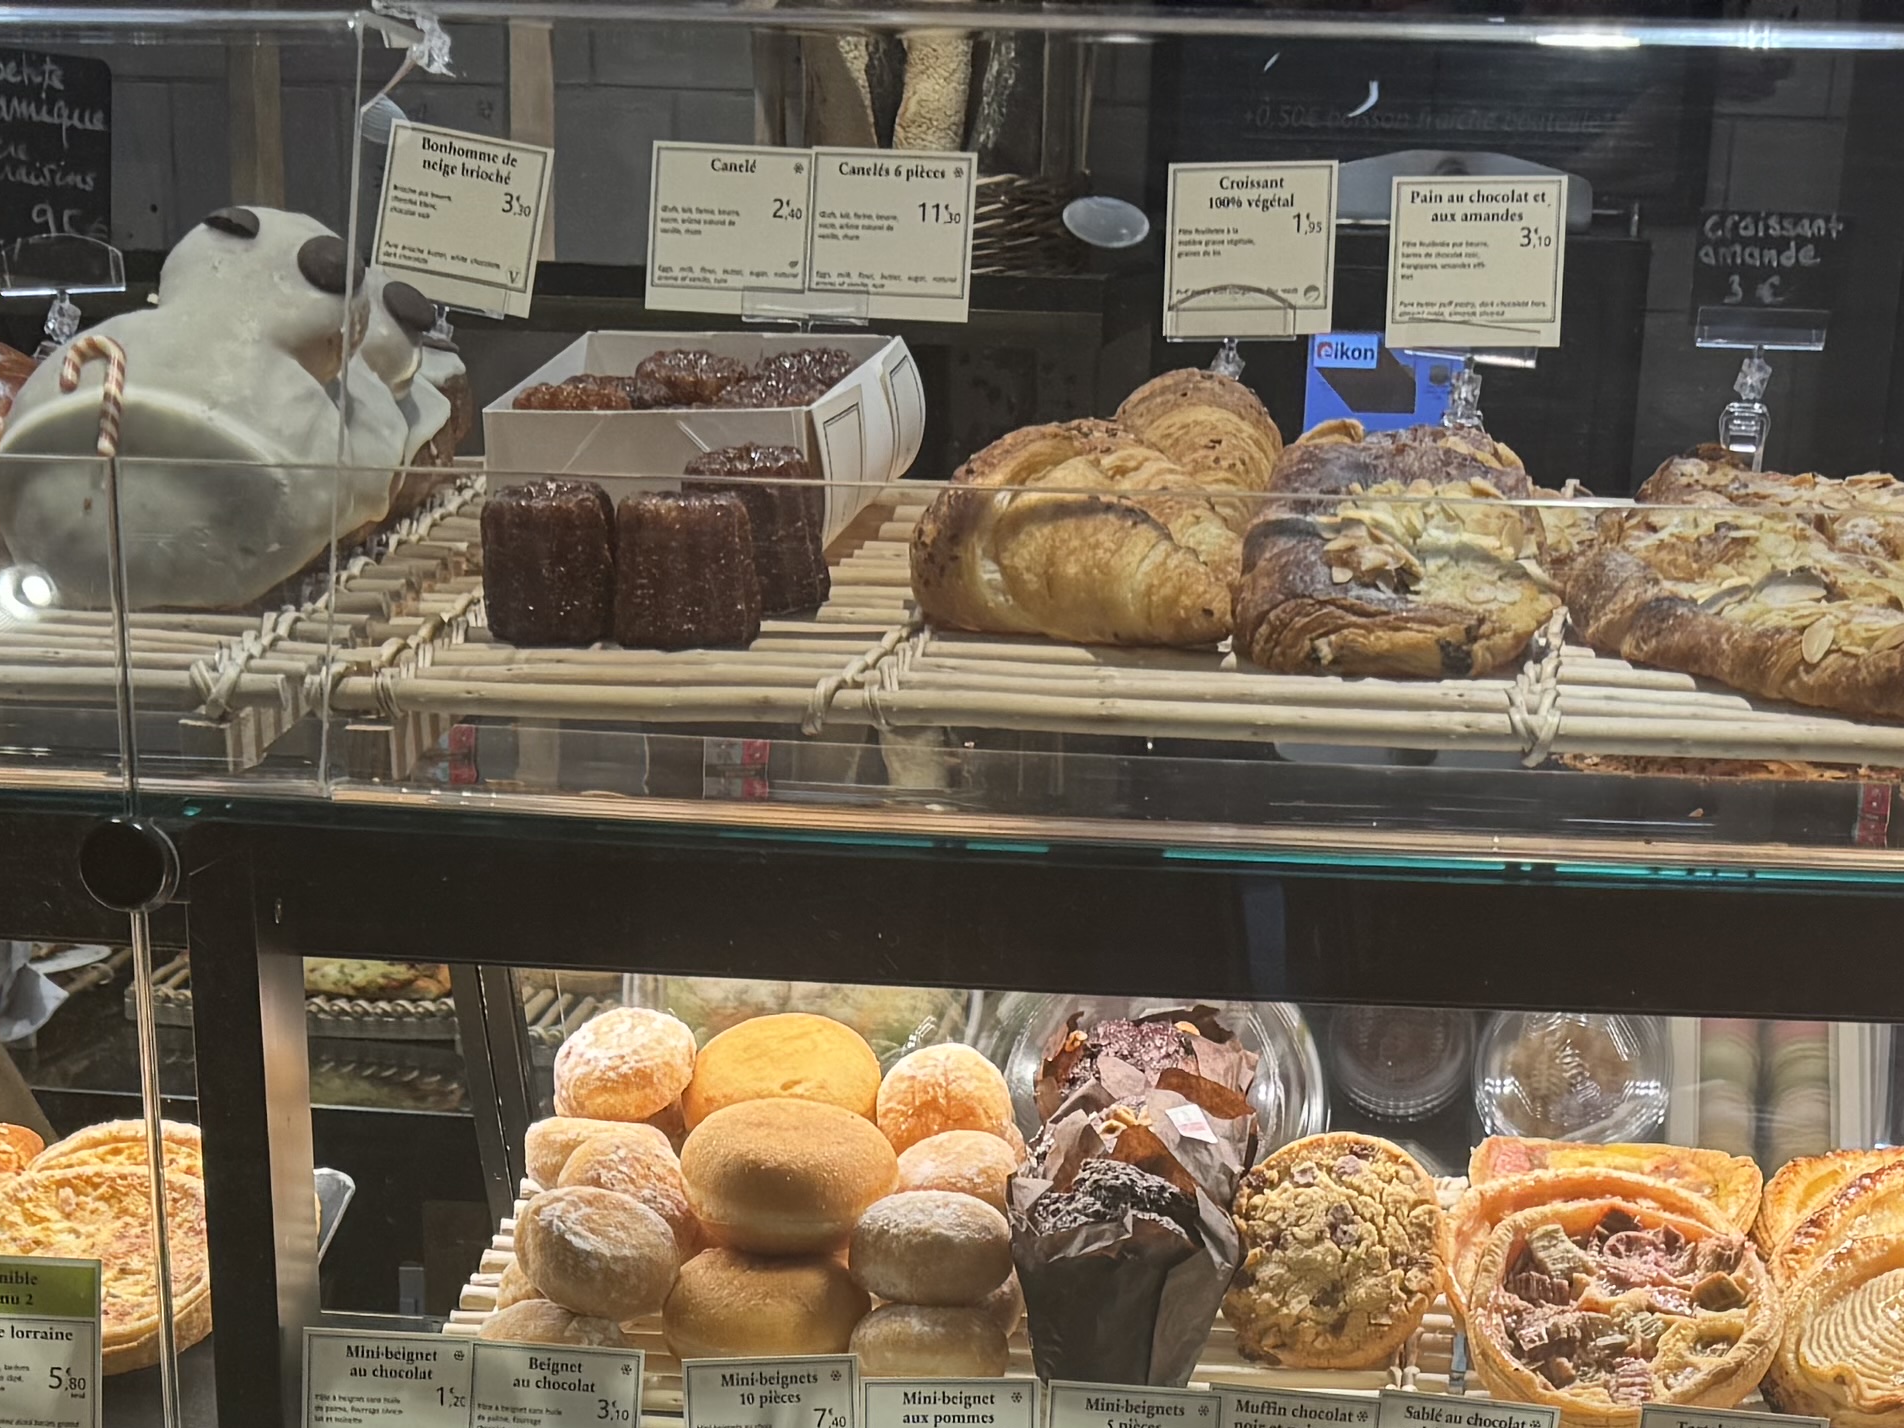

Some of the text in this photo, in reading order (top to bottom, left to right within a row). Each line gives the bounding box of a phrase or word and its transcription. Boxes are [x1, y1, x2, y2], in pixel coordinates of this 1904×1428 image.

[1218, 174, 1285, 190] Croissant
[1208, 192, 1295, 213] 100% végétal
[1409, 187, 1546, 204] Pain au chocolat et
[1430, 206, 1524, 223] aux amandes
[9, 1323, 74, 1342] lorraine
[345, 1343, 438, 1366] Mini-beignet
[348, 1362, 433, 1380] au chocolat
[527, 1355, 582, 1377] Beignet
[511, 1374, 596, 1394] au chocolat
[720, 1368, 818, 1390] Mini-beignets
[738, 1388, 802, 1409] 10 pièces
[1234, 1397, 1355, 1424] Muffin chocolat
[1403, 1404, 1443, 1423] Sablé
[1443, 1412, 1463, 1425] au
